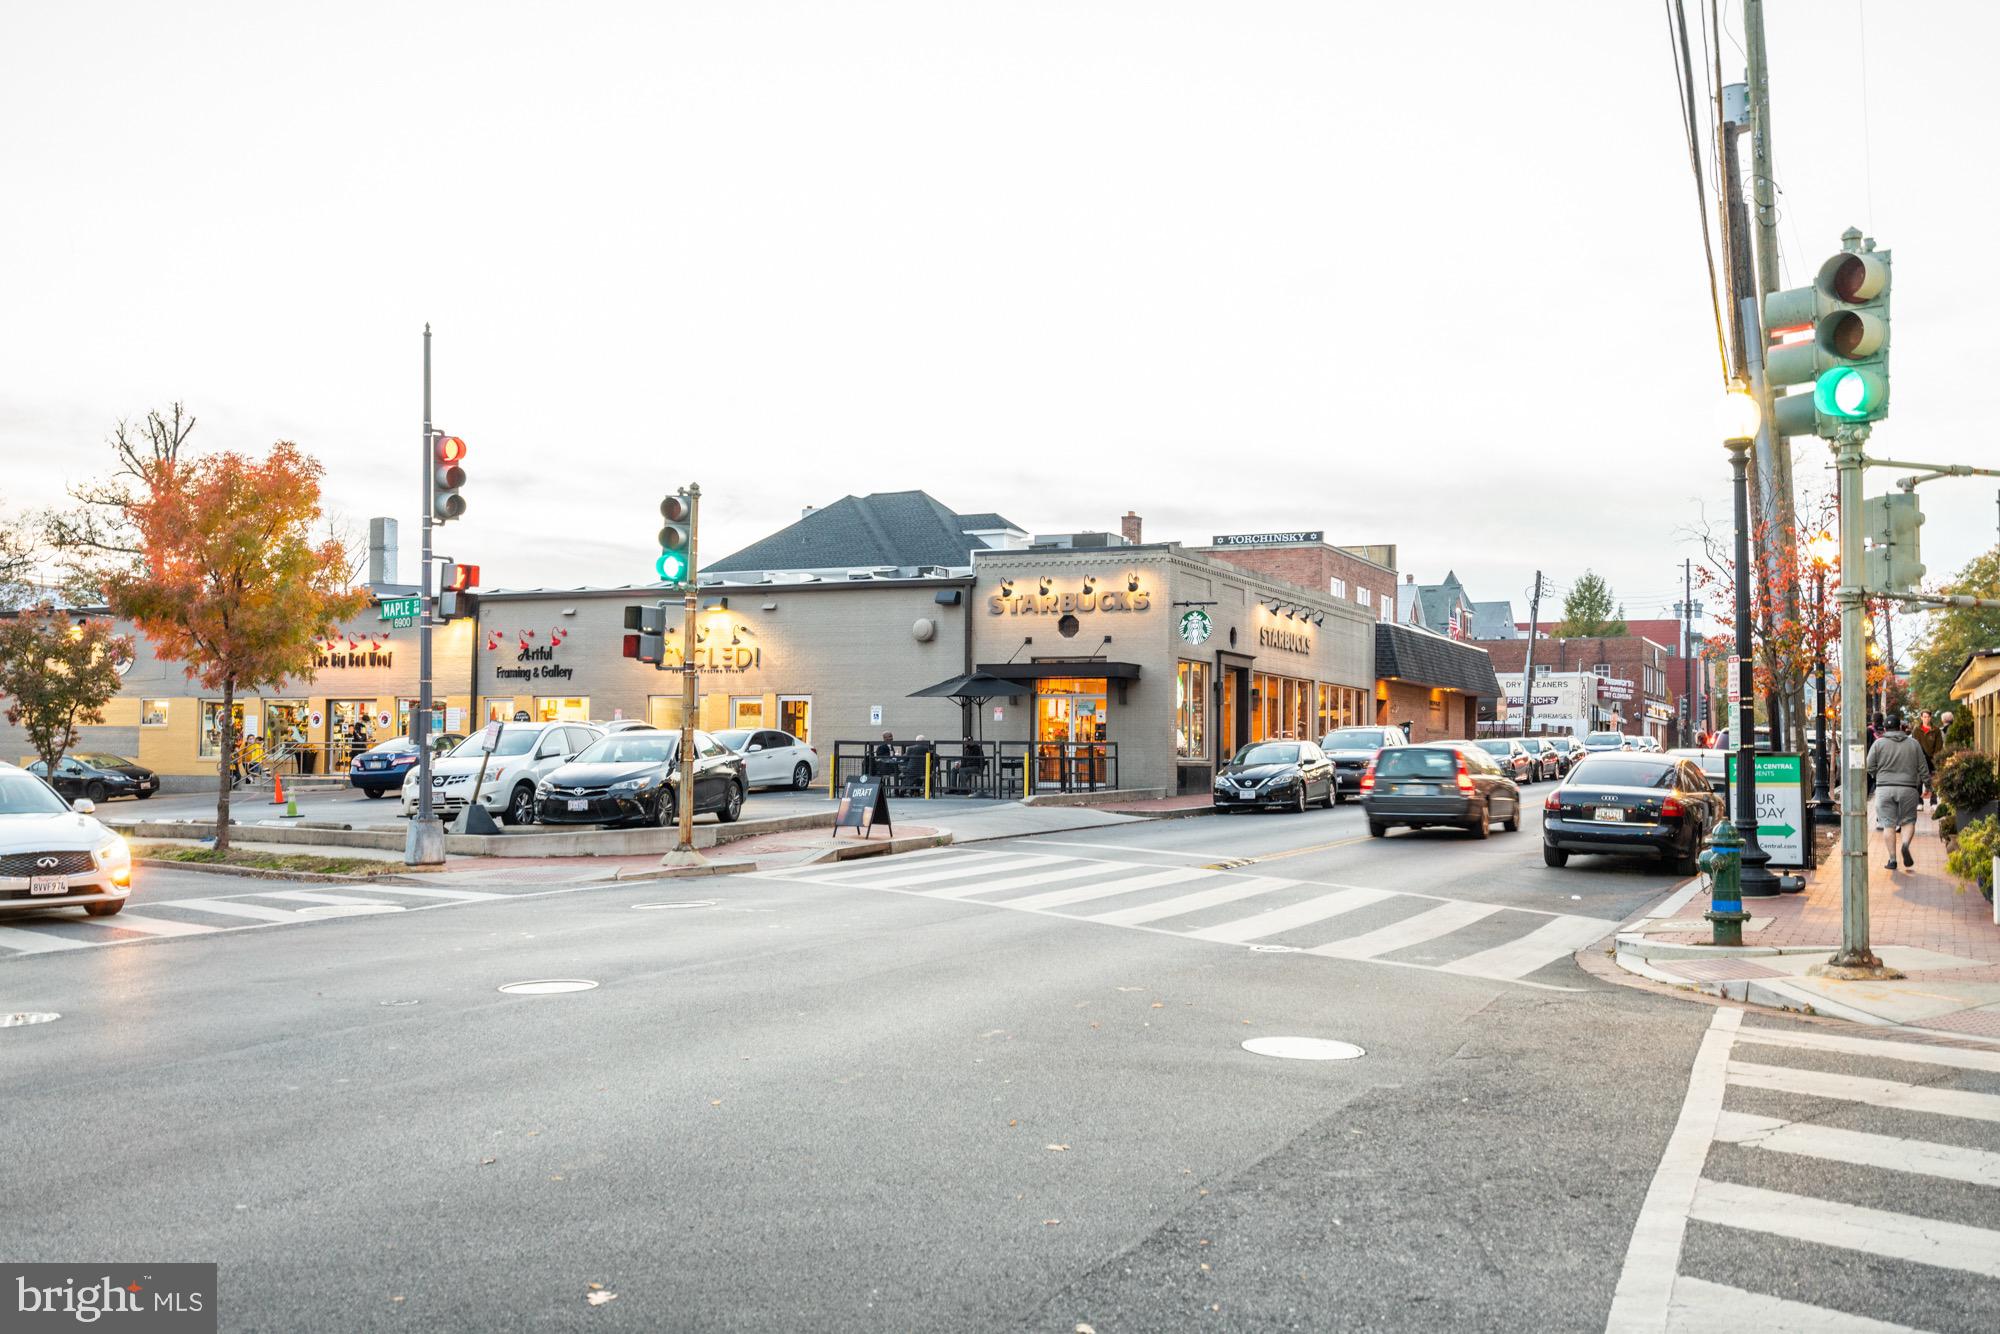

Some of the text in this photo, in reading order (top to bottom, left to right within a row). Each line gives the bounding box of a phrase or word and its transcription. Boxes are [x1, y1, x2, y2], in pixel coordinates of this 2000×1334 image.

[1228, 532, 1306, 545] TORCHINSKY
[383, 601, 410, 617] MAPLE
[989, 591, 1150, 614] STARBUCKS
[394, 617, 411, 628] 6900
[1259, 626, 1310, 655] STARBUCKS
[331, 652, 346, 668] Big
[348, 652, 366, 667] Bad
[368, 652, 392, 668] Woof
[517, 646, 553, 661] Artful
[496, 665, 573, 681] Framing & Gallery
[1531, 681, 1569, 689] LEANERS
[852, 788, 873, 797] DRAFT
